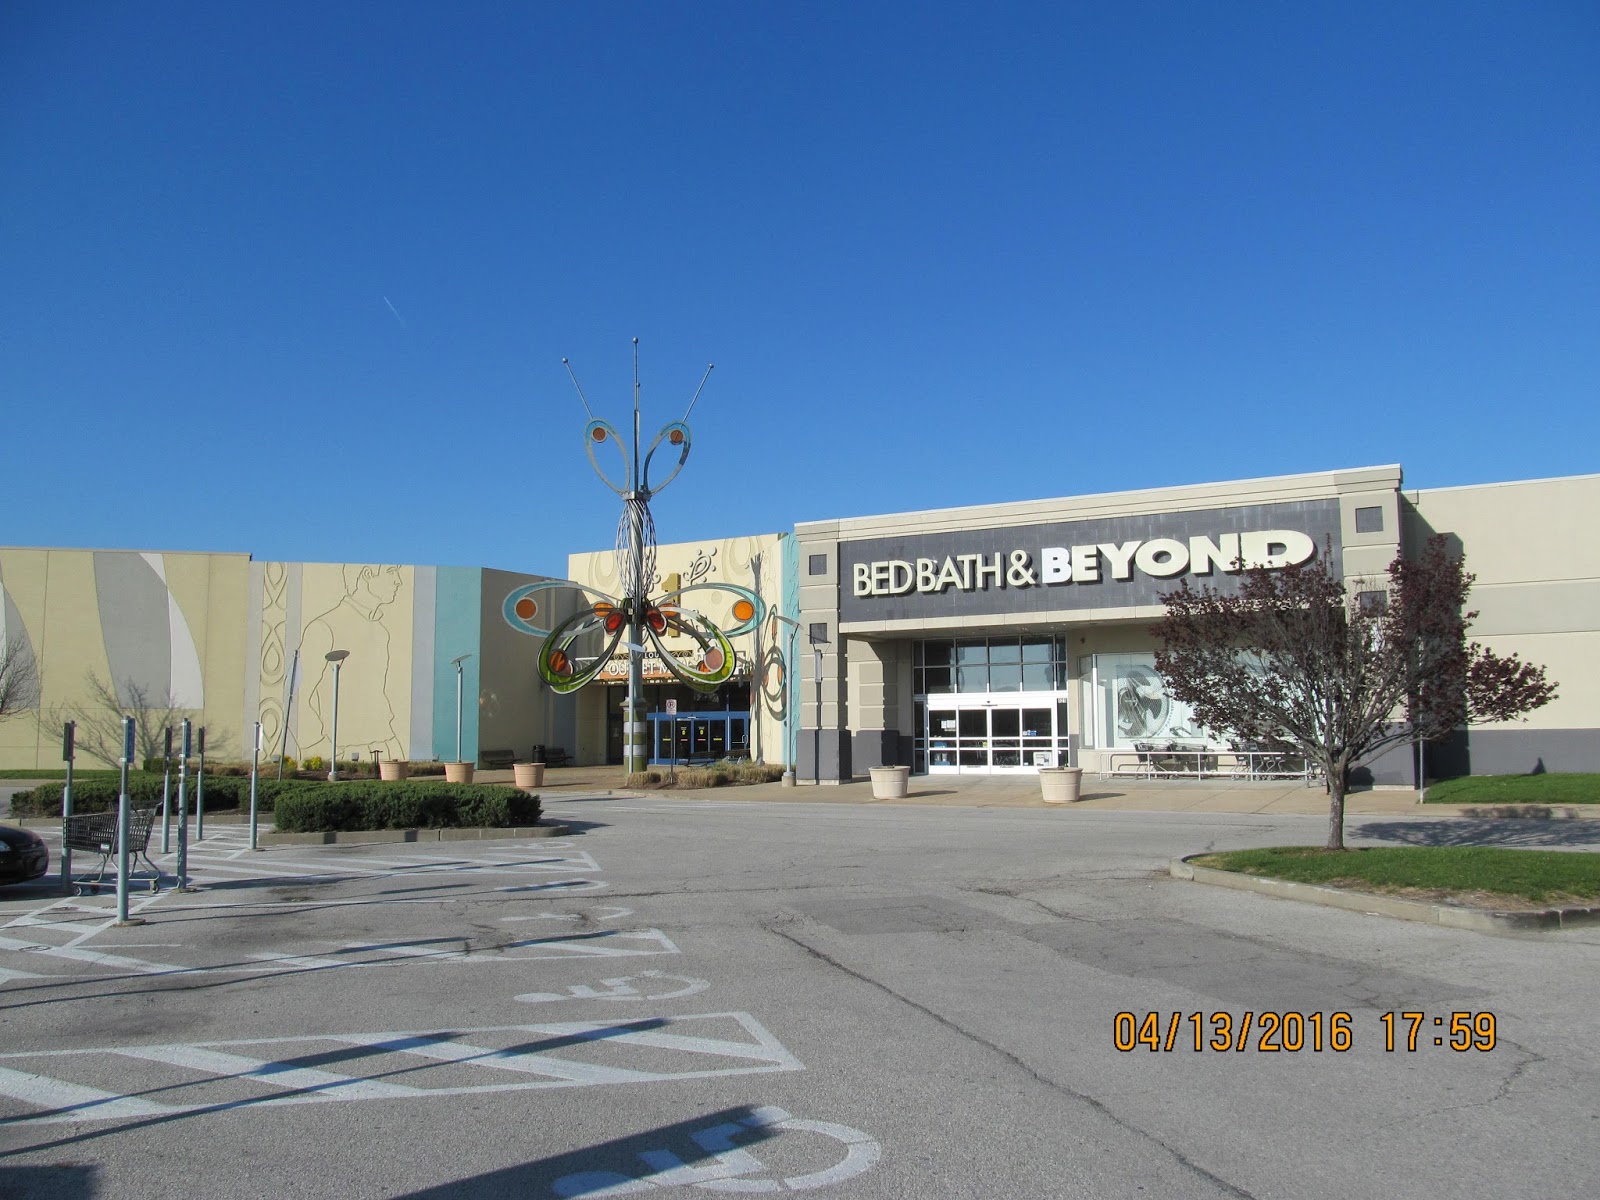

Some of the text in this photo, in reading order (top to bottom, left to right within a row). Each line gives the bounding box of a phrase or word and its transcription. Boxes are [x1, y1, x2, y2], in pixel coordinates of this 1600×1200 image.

[853, 529, 1314, 597] BED BATH & BEYOND
[609, 661, 655, 676] OUET
